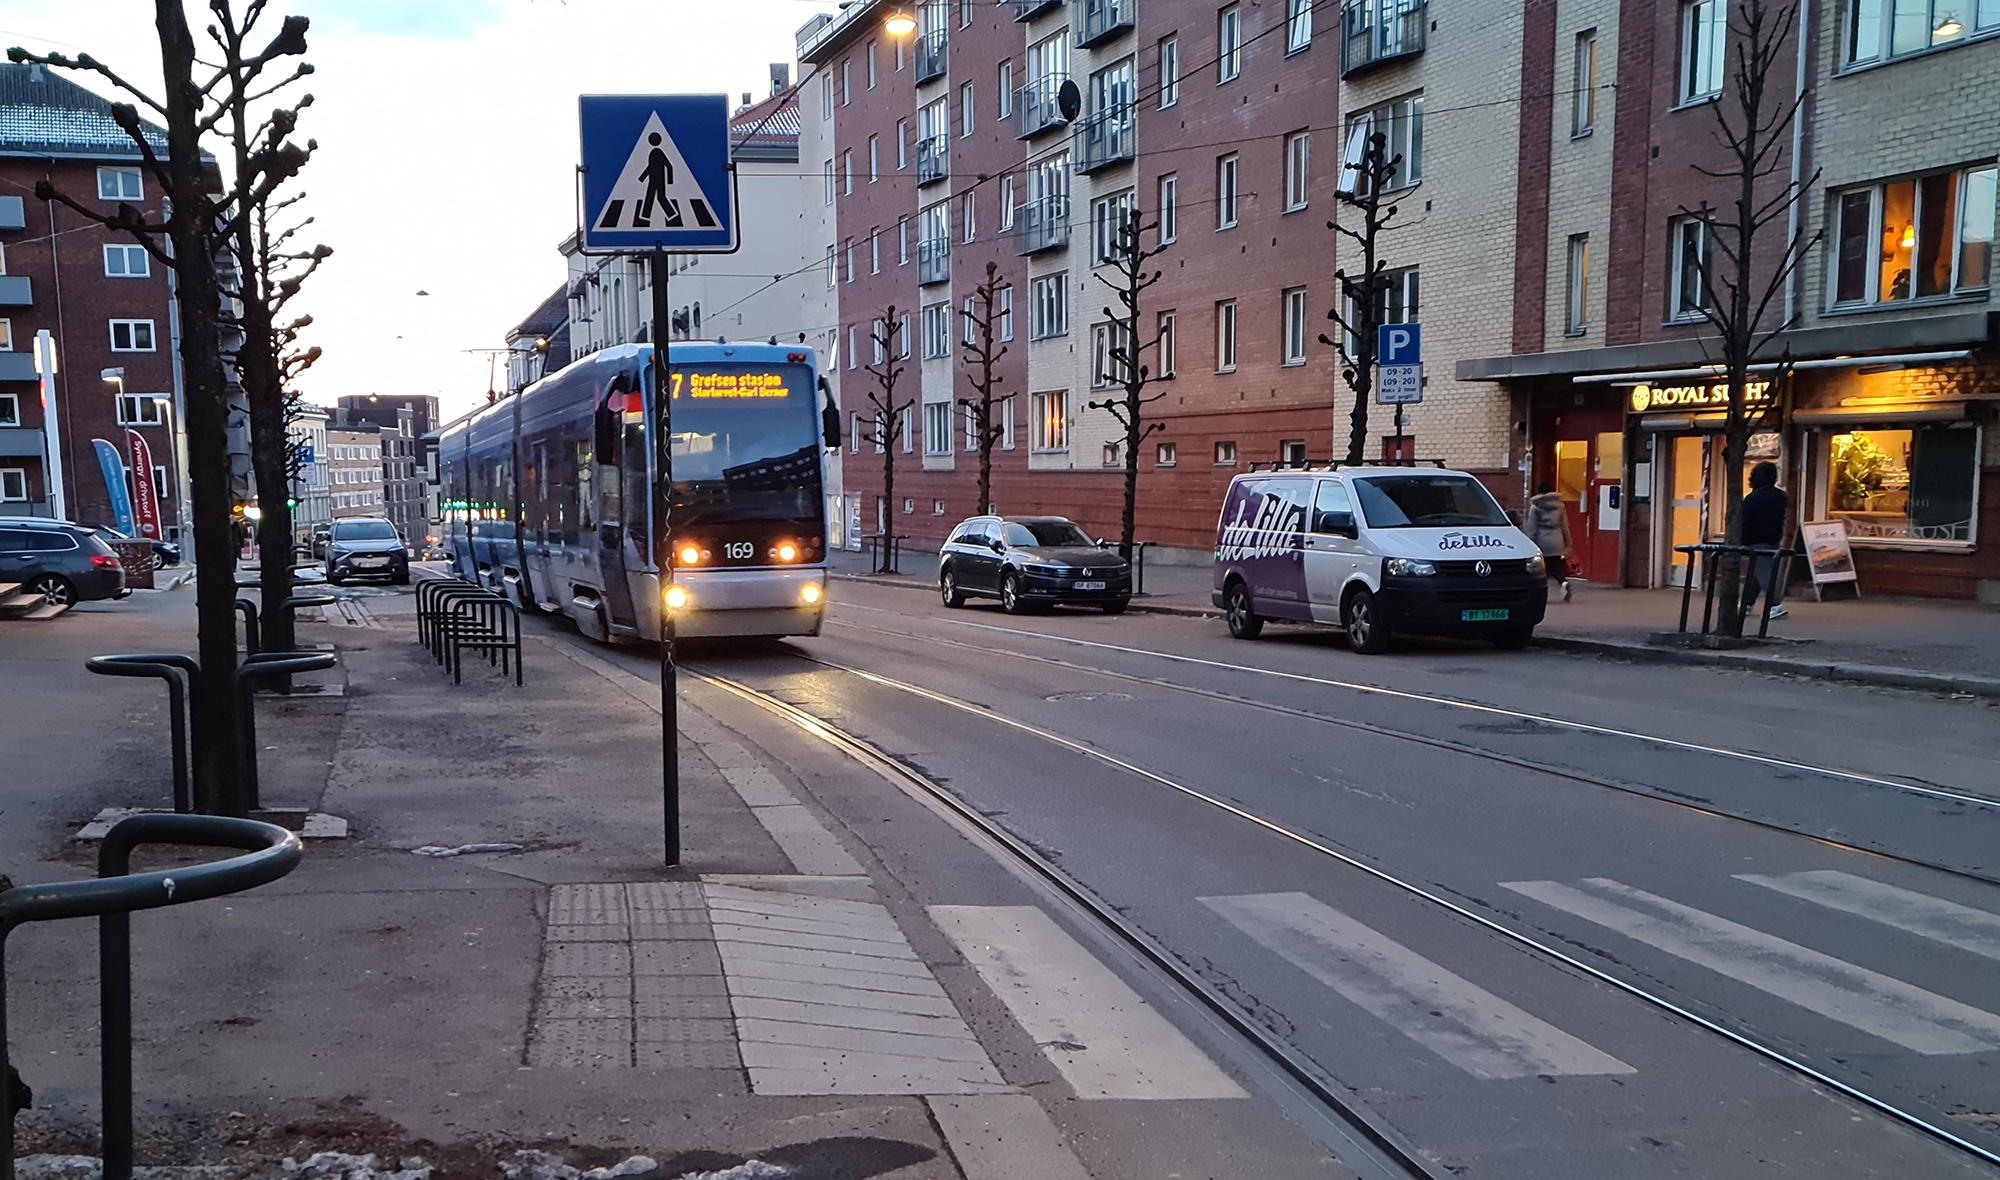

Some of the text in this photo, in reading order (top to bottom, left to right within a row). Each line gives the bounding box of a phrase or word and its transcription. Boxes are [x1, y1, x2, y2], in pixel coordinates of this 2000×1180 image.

[1389, 329, 1411, 360] P
[671, 373, 683, 399] 7
[690, 373, 782, 387] Grefsen stasjon
[759, 387, 790, 398] Berner
[1652, 386, 1709, 405] ROYAL
[134, 440, 145, 479] Synergy
[139, 480, 152, 518] drivstoff
[724, 541, 754, 559] 169
[1482, 610, 1506, 619] 17966
